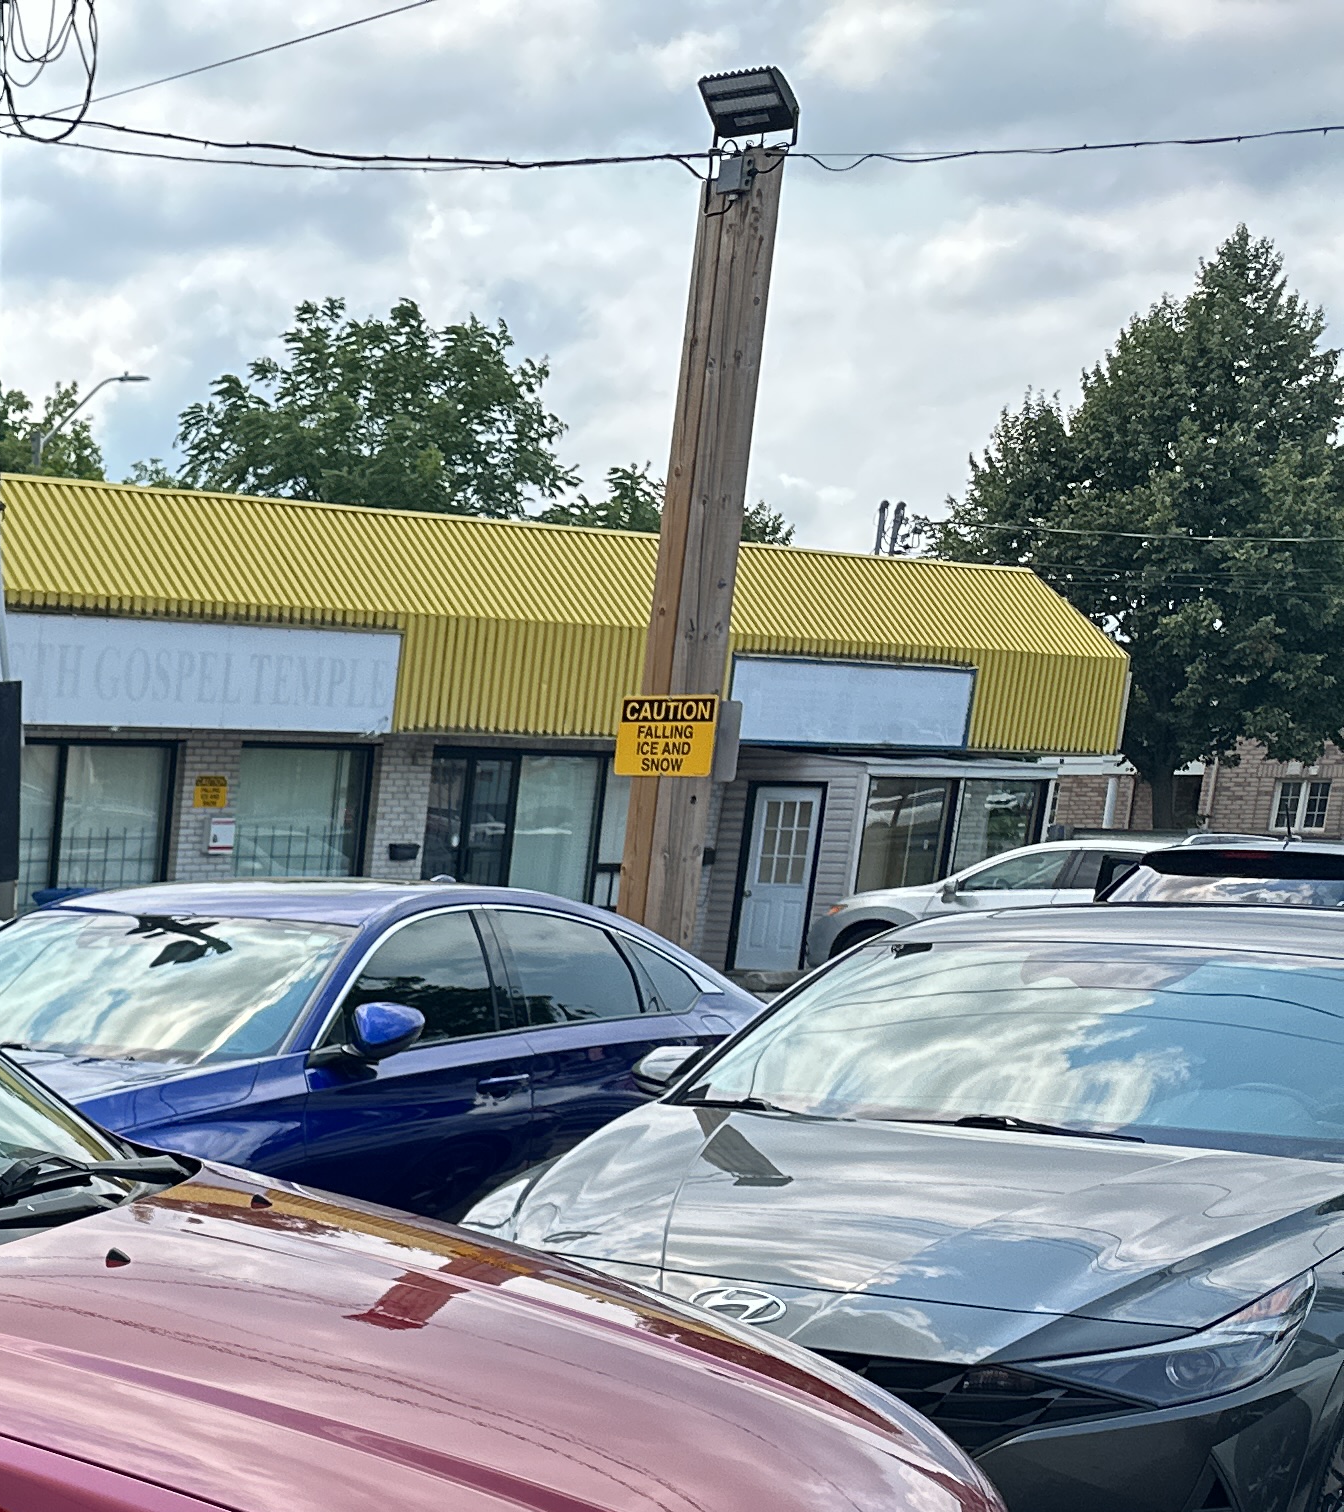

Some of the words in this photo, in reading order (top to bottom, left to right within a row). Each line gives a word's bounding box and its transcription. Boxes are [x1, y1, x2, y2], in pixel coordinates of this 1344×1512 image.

[93, 645, 240, 704] GOSPEL
[250, 653, 391, 710] TEMPLE
[626, 701, 711, 720] CAUTION
[637, 725, 693, 739] FALLING
[636, 742, 659, 755] ICE
[661, 742, 691, 755] AND
[641, 758, 683, 772] SNOW
